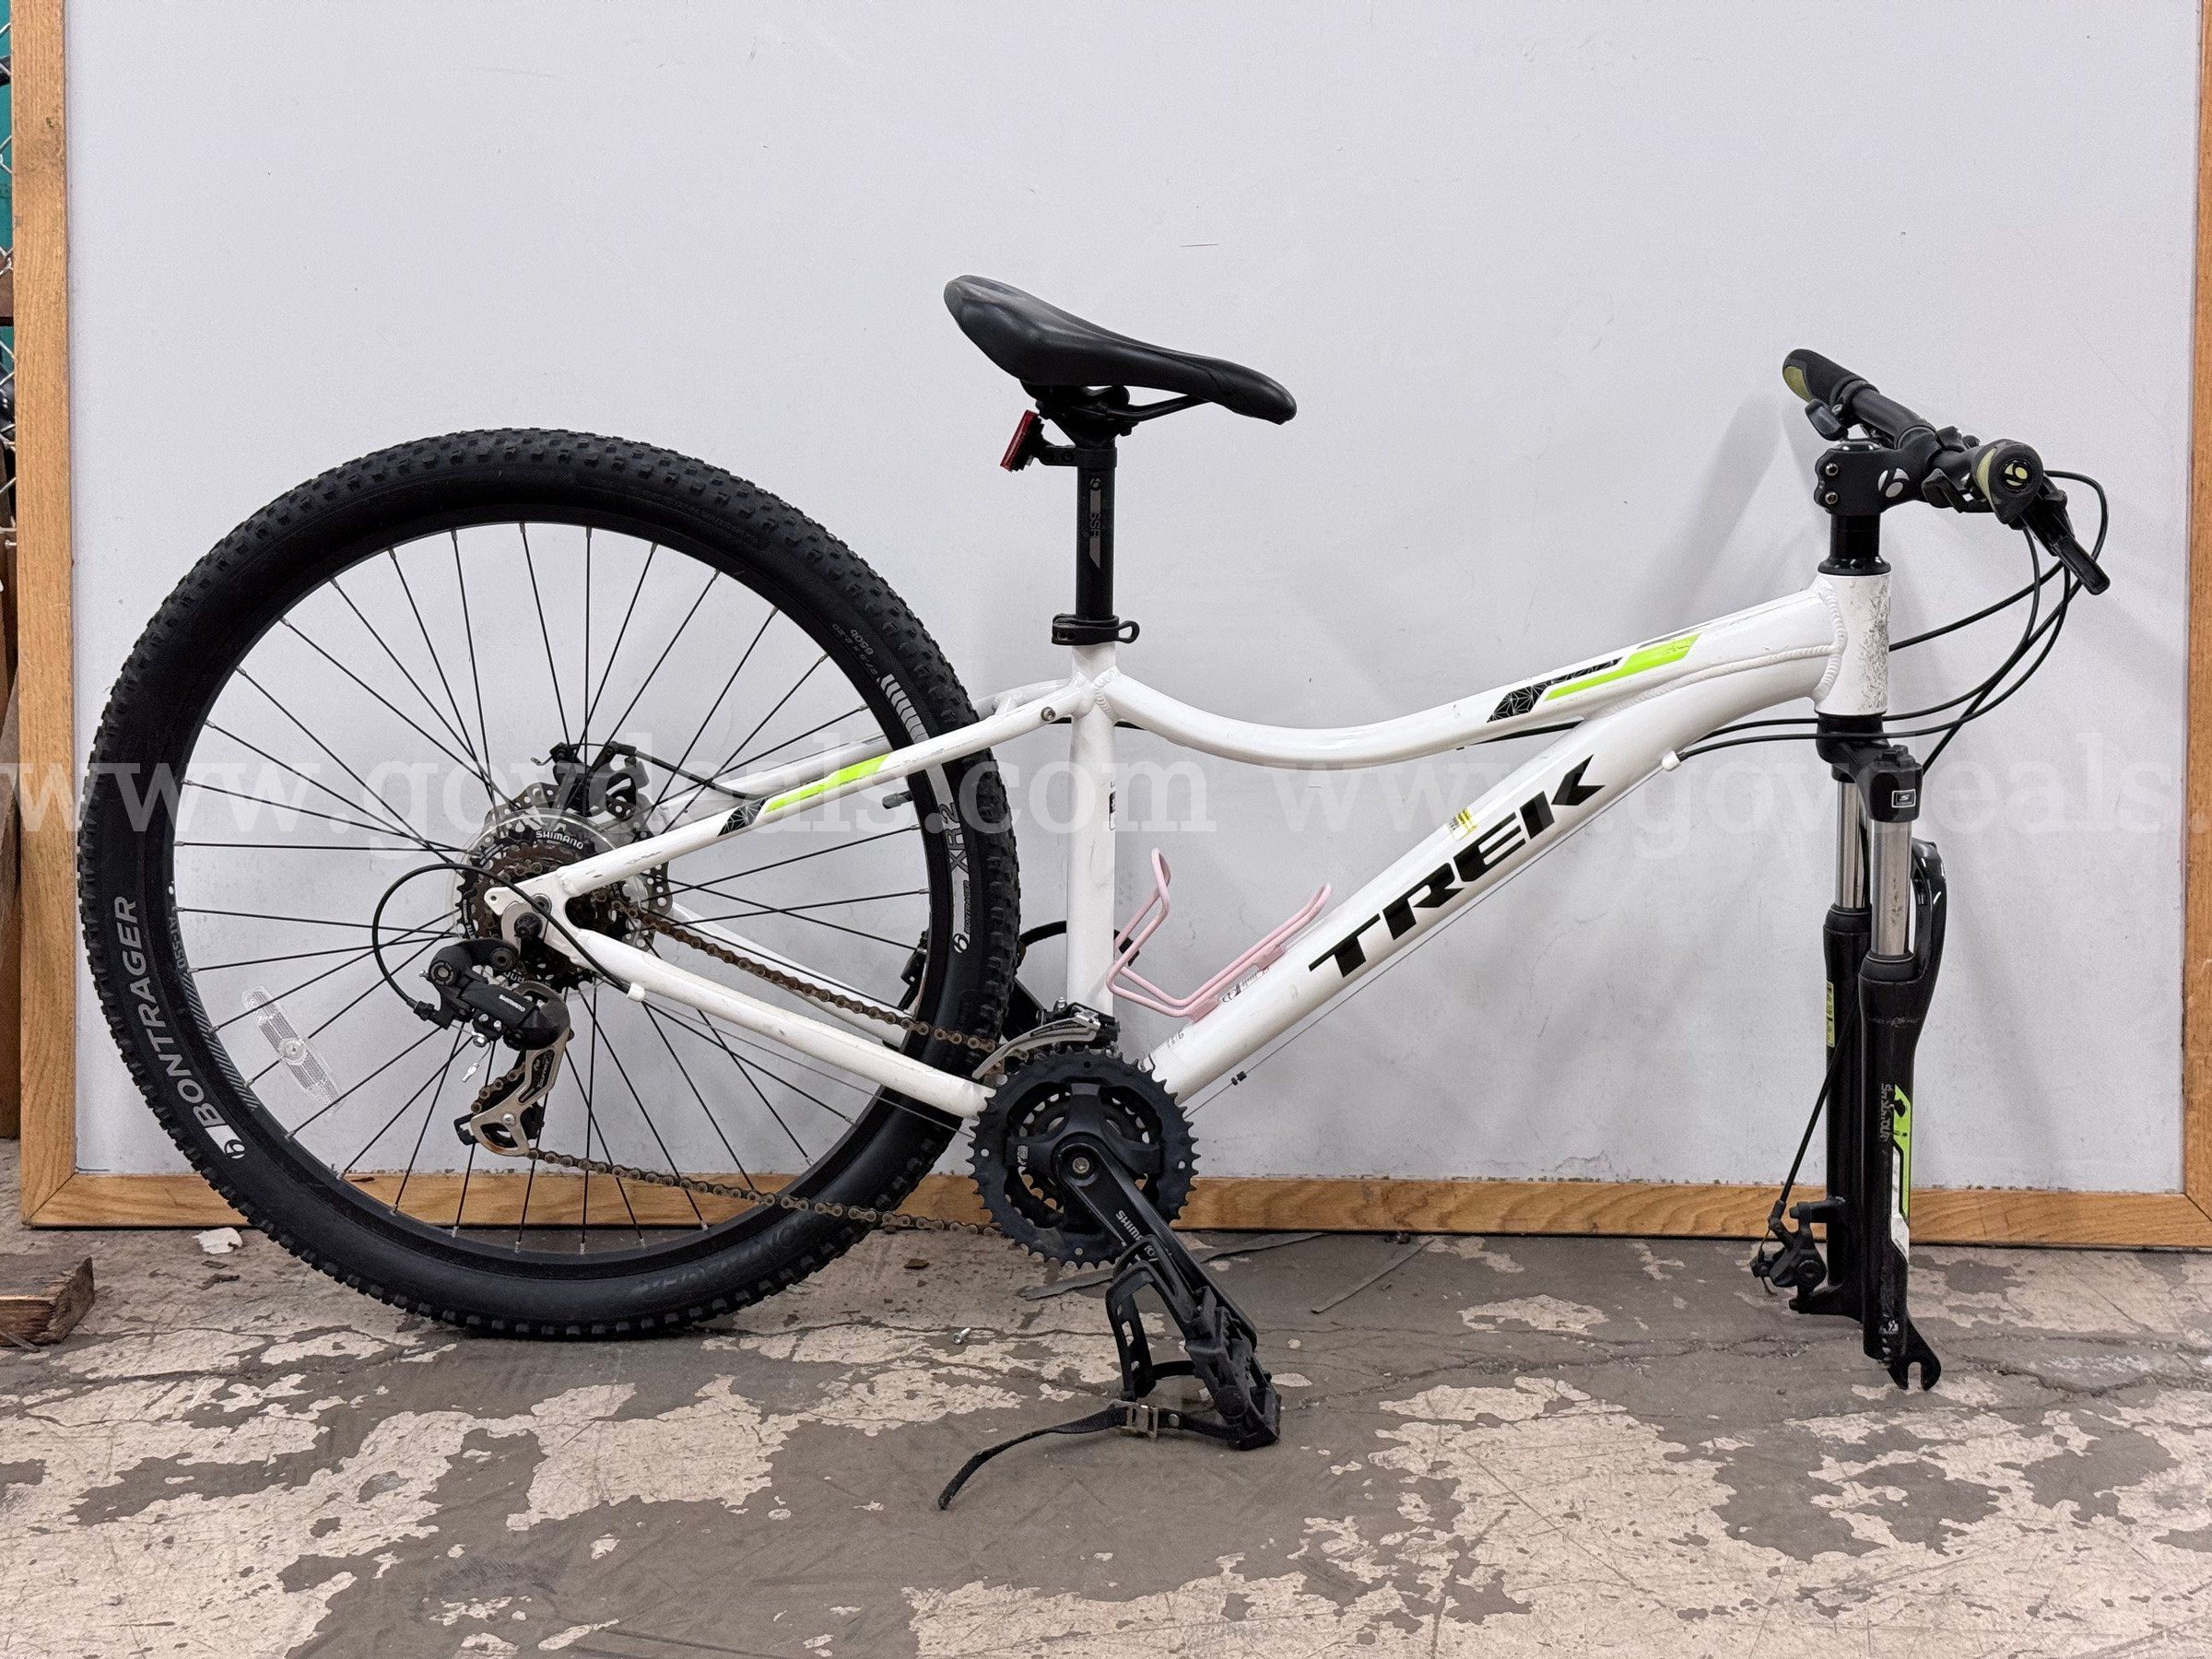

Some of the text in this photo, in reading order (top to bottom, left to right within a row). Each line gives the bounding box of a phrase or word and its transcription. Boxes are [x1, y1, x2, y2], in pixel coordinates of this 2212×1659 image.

[535, 830, 583, 851] SHIMANO
[939, 802, 969, 871] XR2
[1308, 754, 1606, 978] TREK
[963, 880, 971, 935] BONTRAGER
[114, 896, 227, 1128] BONTRAGER
